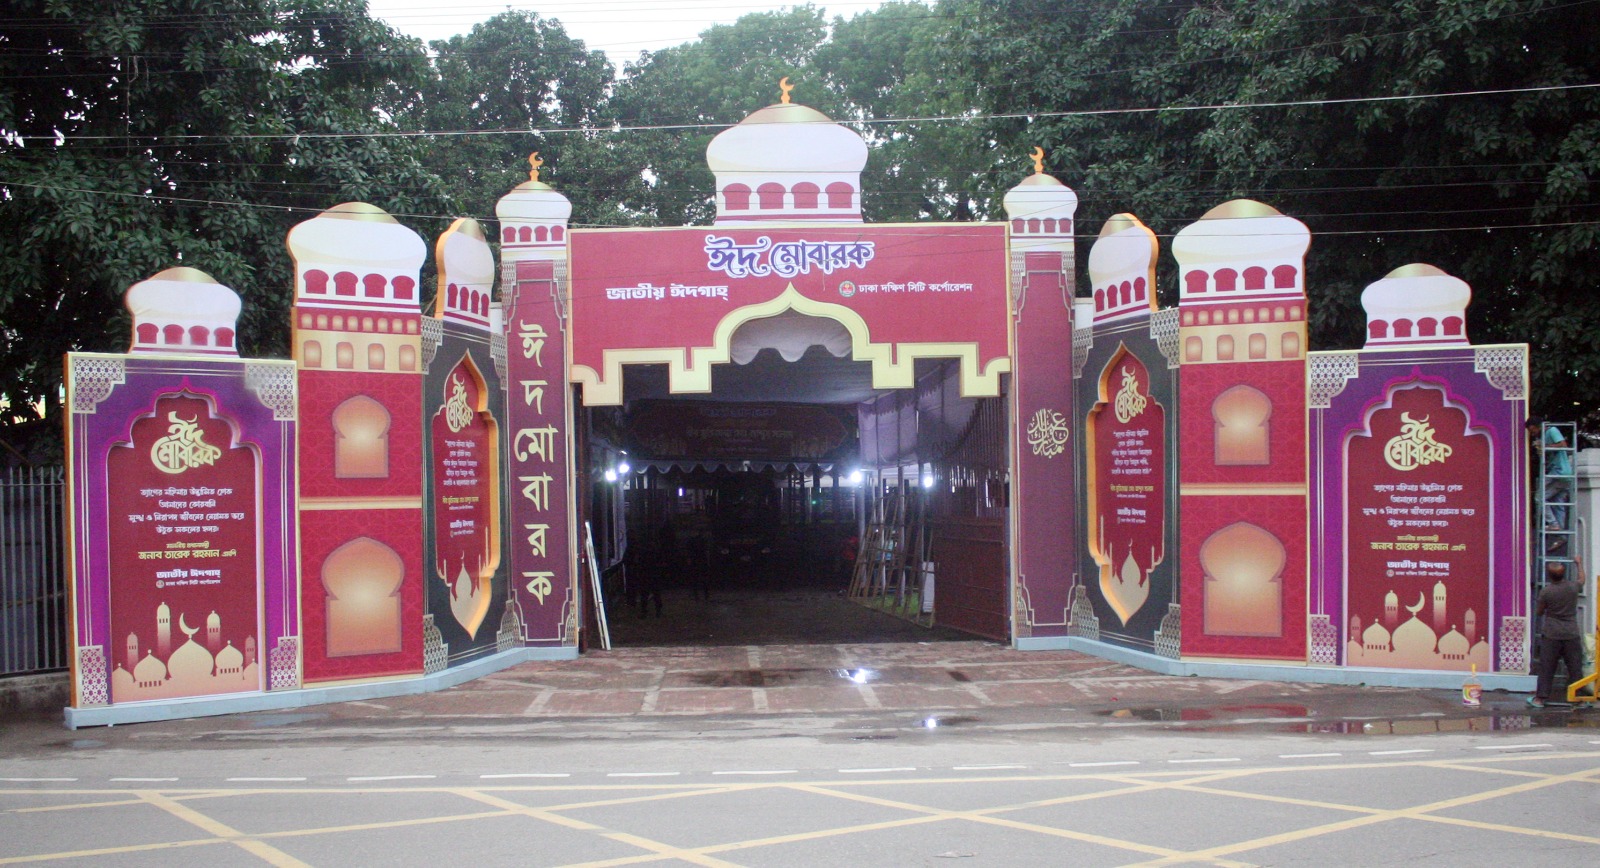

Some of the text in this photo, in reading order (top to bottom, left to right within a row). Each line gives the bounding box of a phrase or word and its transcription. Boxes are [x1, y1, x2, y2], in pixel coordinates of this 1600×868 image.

[704, 235, 874, 278] ঈদ মোবারক
[606, 283, 728, 301] জাতীয় ঈদগাহ্
[858, 281, 972, 293] ঢাকা দক্ষিণ সিটি কর্পোরেশন
[168, 411, 204, 444] ঈদ
[1400, 412, 1435, 445] ঈদ
[1371, 542, 1393, 550] জনাব
[1395, 542, 1420, 551] তারেক
[1422, 542, 1449, 551] রহমান
[138, 551, 162, 560] জনাব
[165, 550, 190, 559] তারেক
[192, 550, 220, 558] রহমান
[1387, 560, 1417, 569] জাতীয়
[156, 569, 187, 578] জাতীয়
